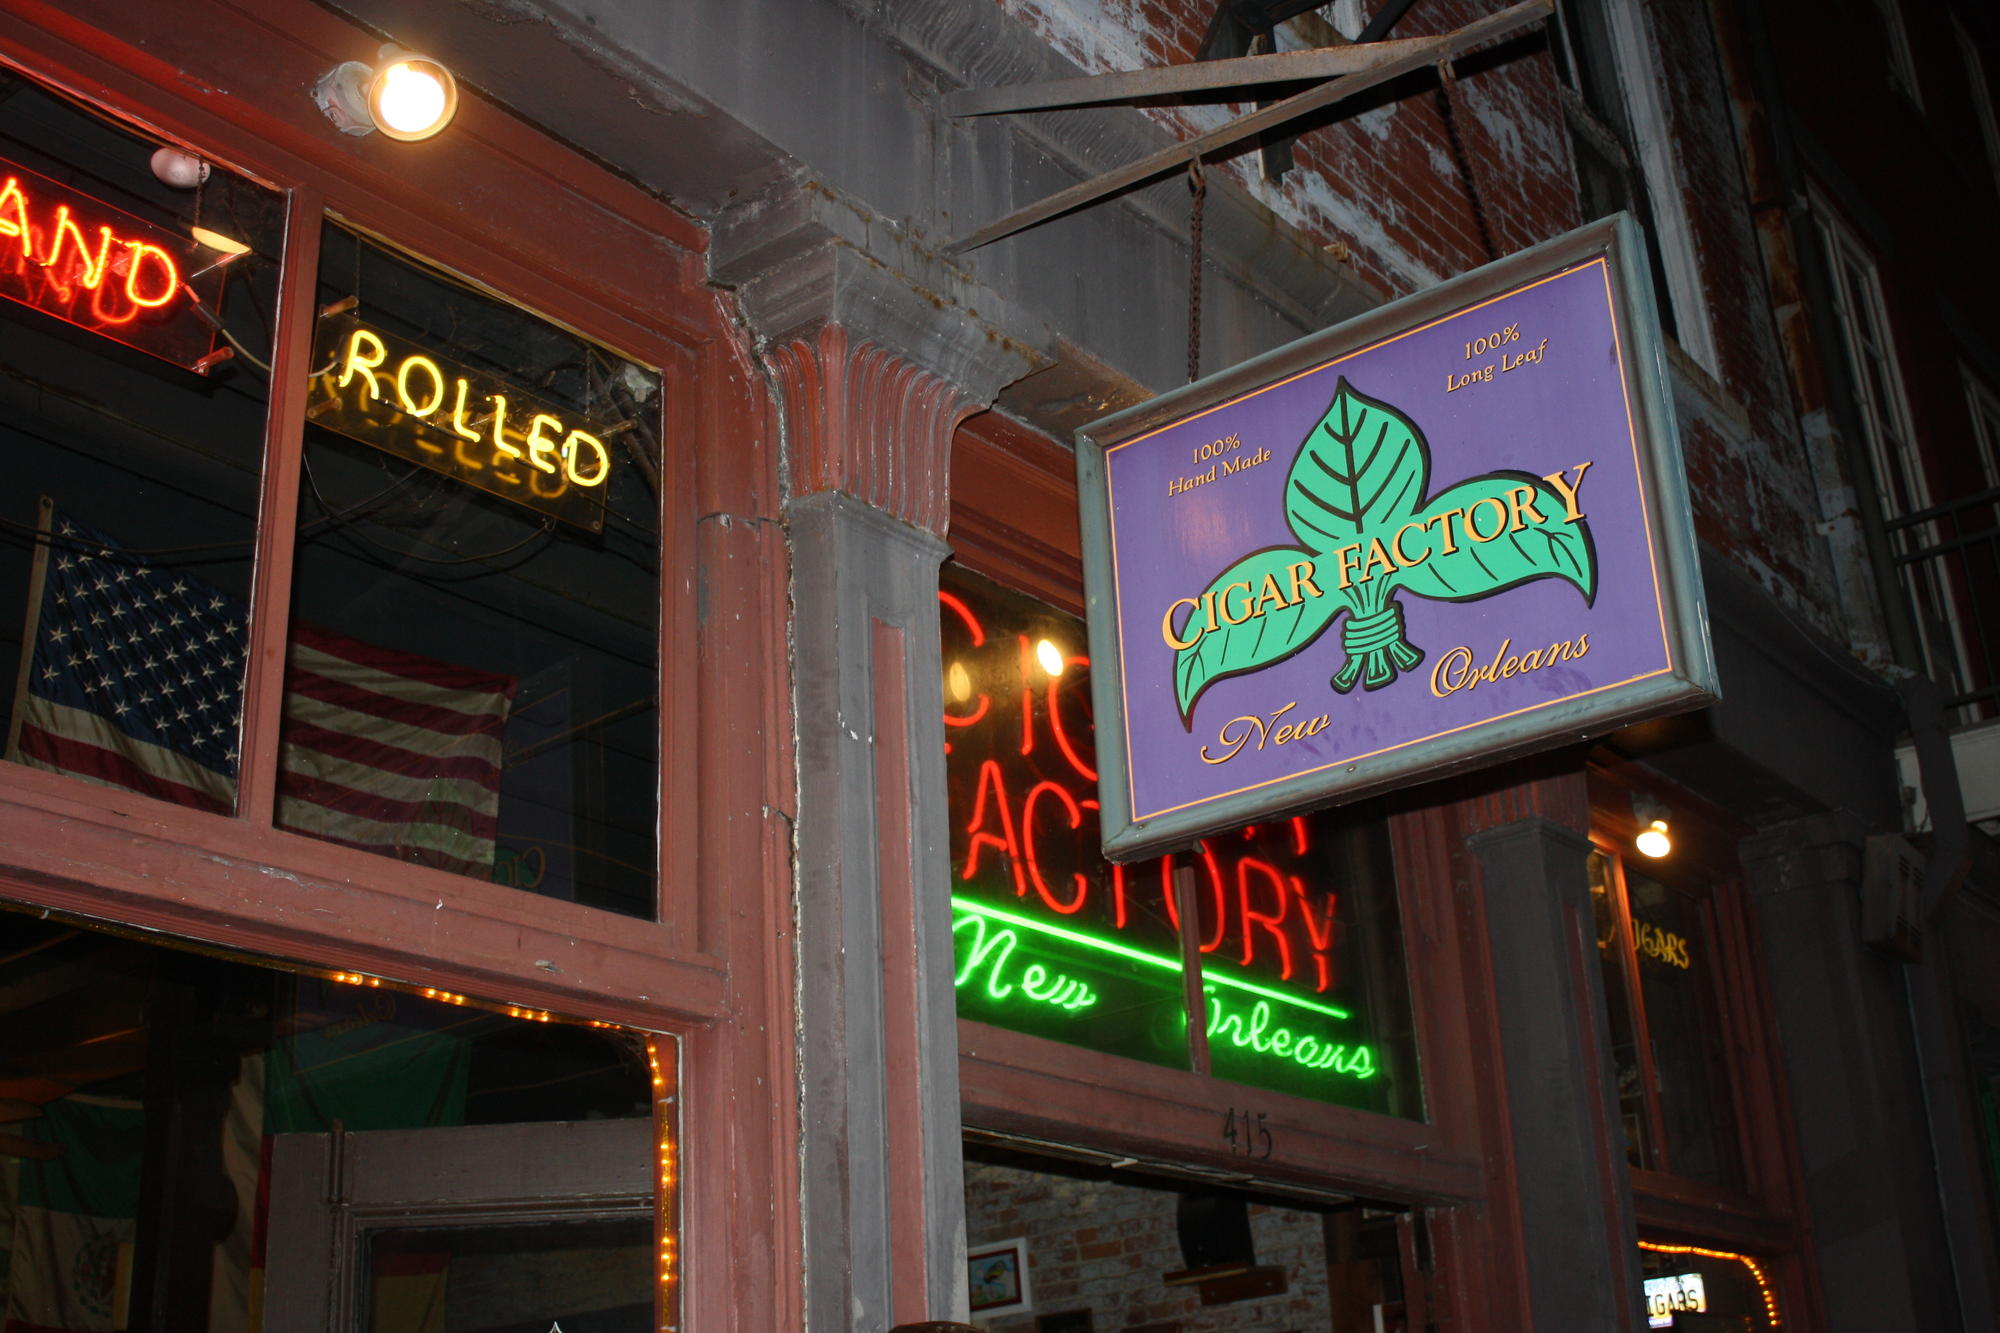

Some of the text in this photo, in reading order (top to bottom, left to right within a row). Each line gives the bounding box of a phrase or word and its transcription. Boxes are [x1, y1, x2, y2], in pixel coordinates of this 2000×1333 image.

[1446, 337, 1549, 393] Long Leaf
[1465, 321, 1521, 360] 100%
[338, 329, 609, 487] ROLLED
[1167, 446, 1272, 497] Hand Made
[1193, 432, 1242, 465] 100%
[1160, 461, 1594, 652] CIGAR FACTORY
[1199, 628, 1591, 765] New Orleans
[951, 913, 1097, 1011] New
[1223, 1106, 1273, 1161] 415
[1645, 1288, 1699, 1317] IGARS
